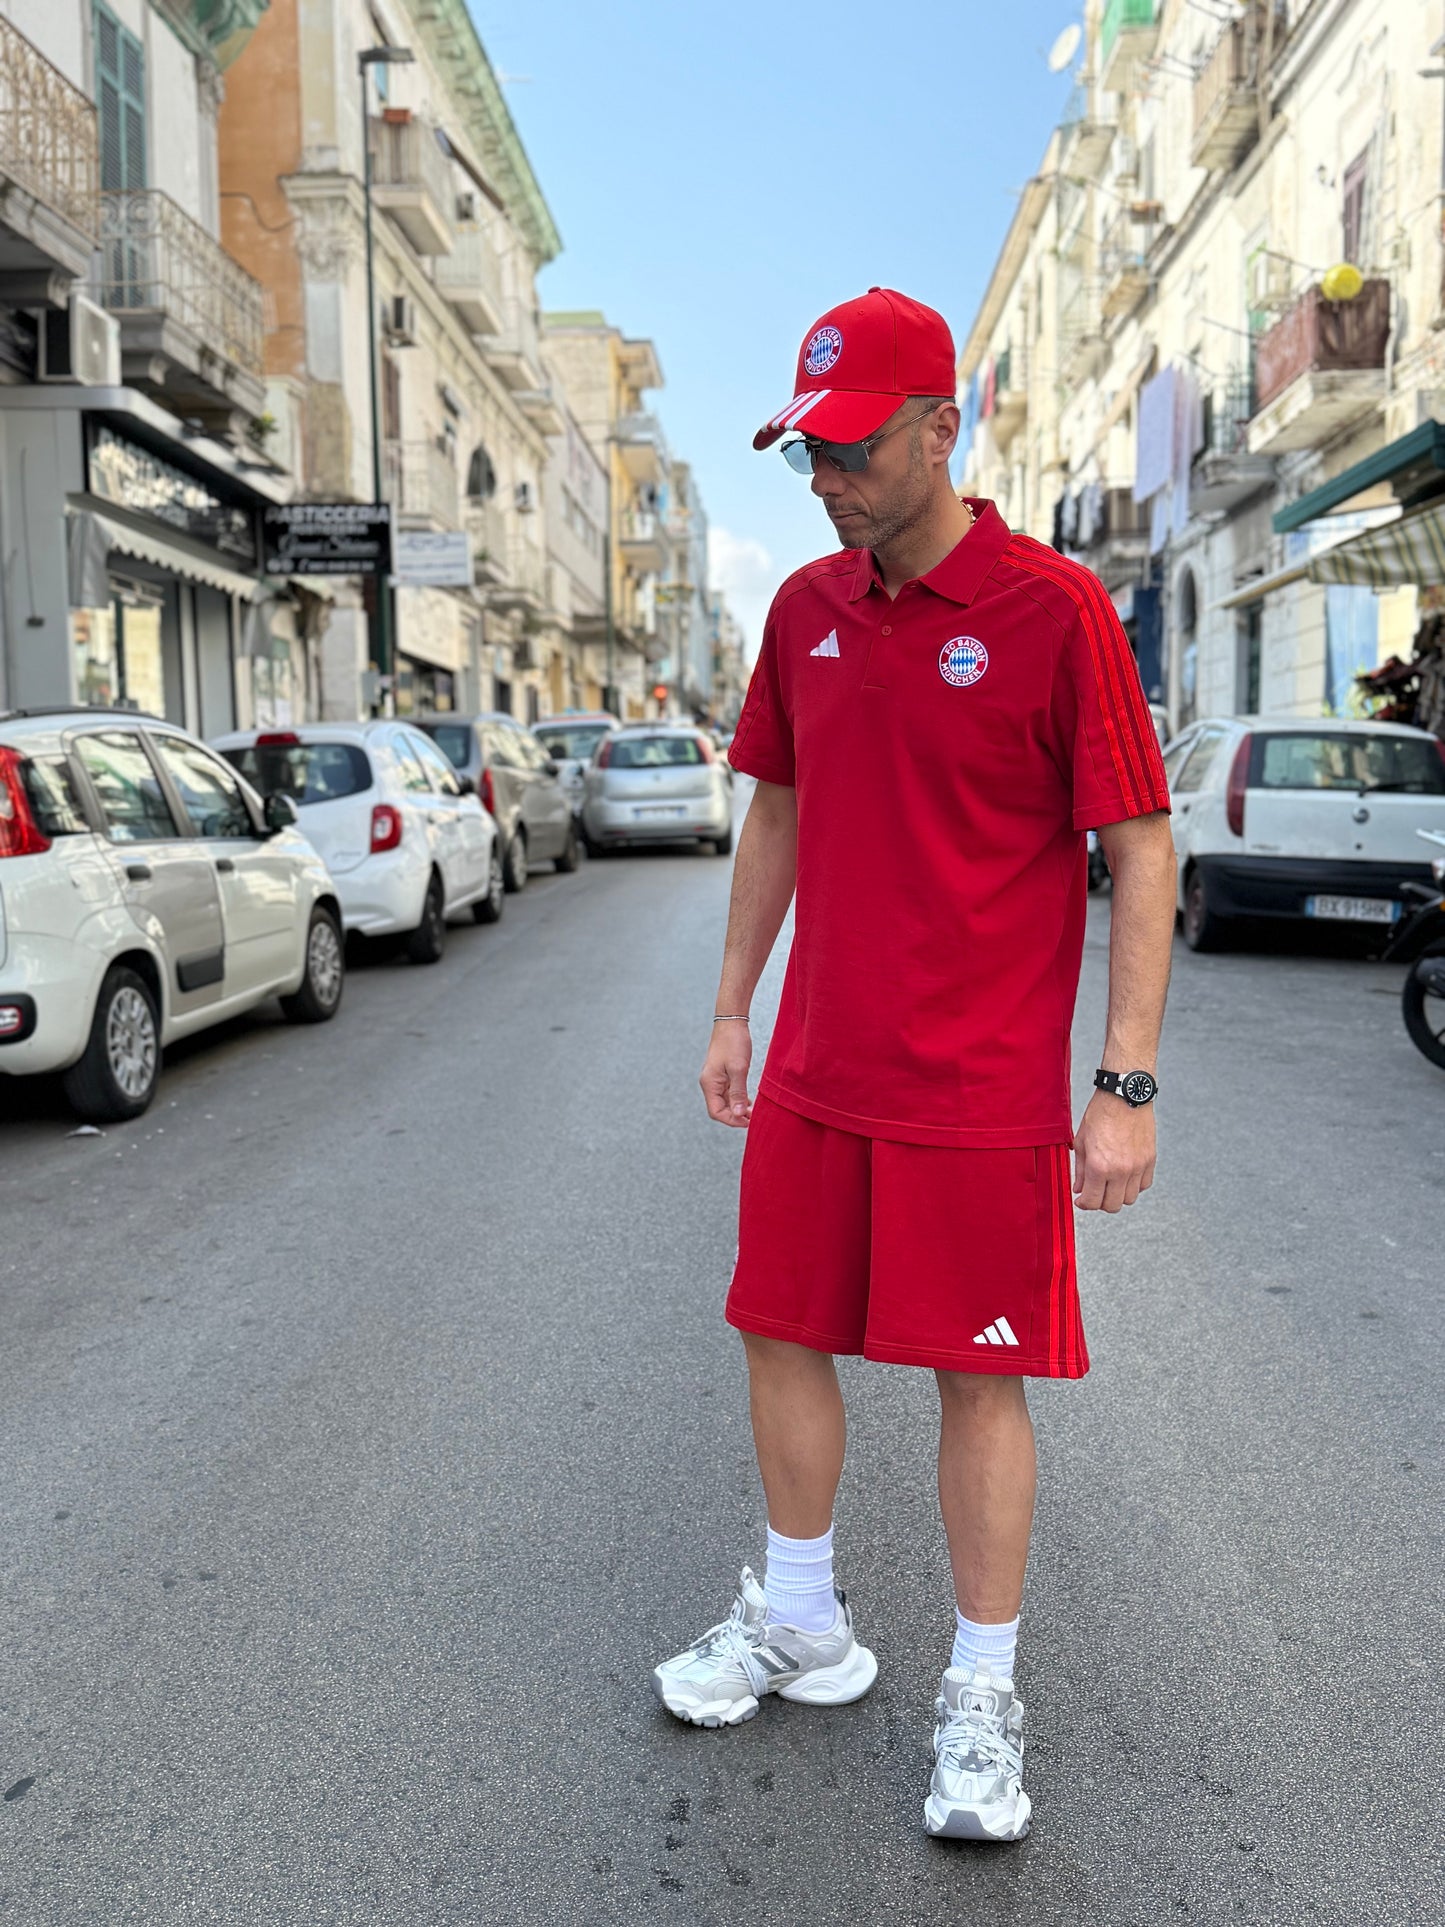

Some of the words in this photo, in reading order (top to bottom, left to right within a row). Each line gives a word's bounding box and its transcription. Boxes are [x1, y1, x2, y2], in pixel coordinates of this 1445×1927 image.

[817, 330, 840, 347] BAYERN
[264, 505, 389, 523] PASTICCERIA
[945, 643, 956, 655] FC
[957, 639, 986, 662] BAYERN
